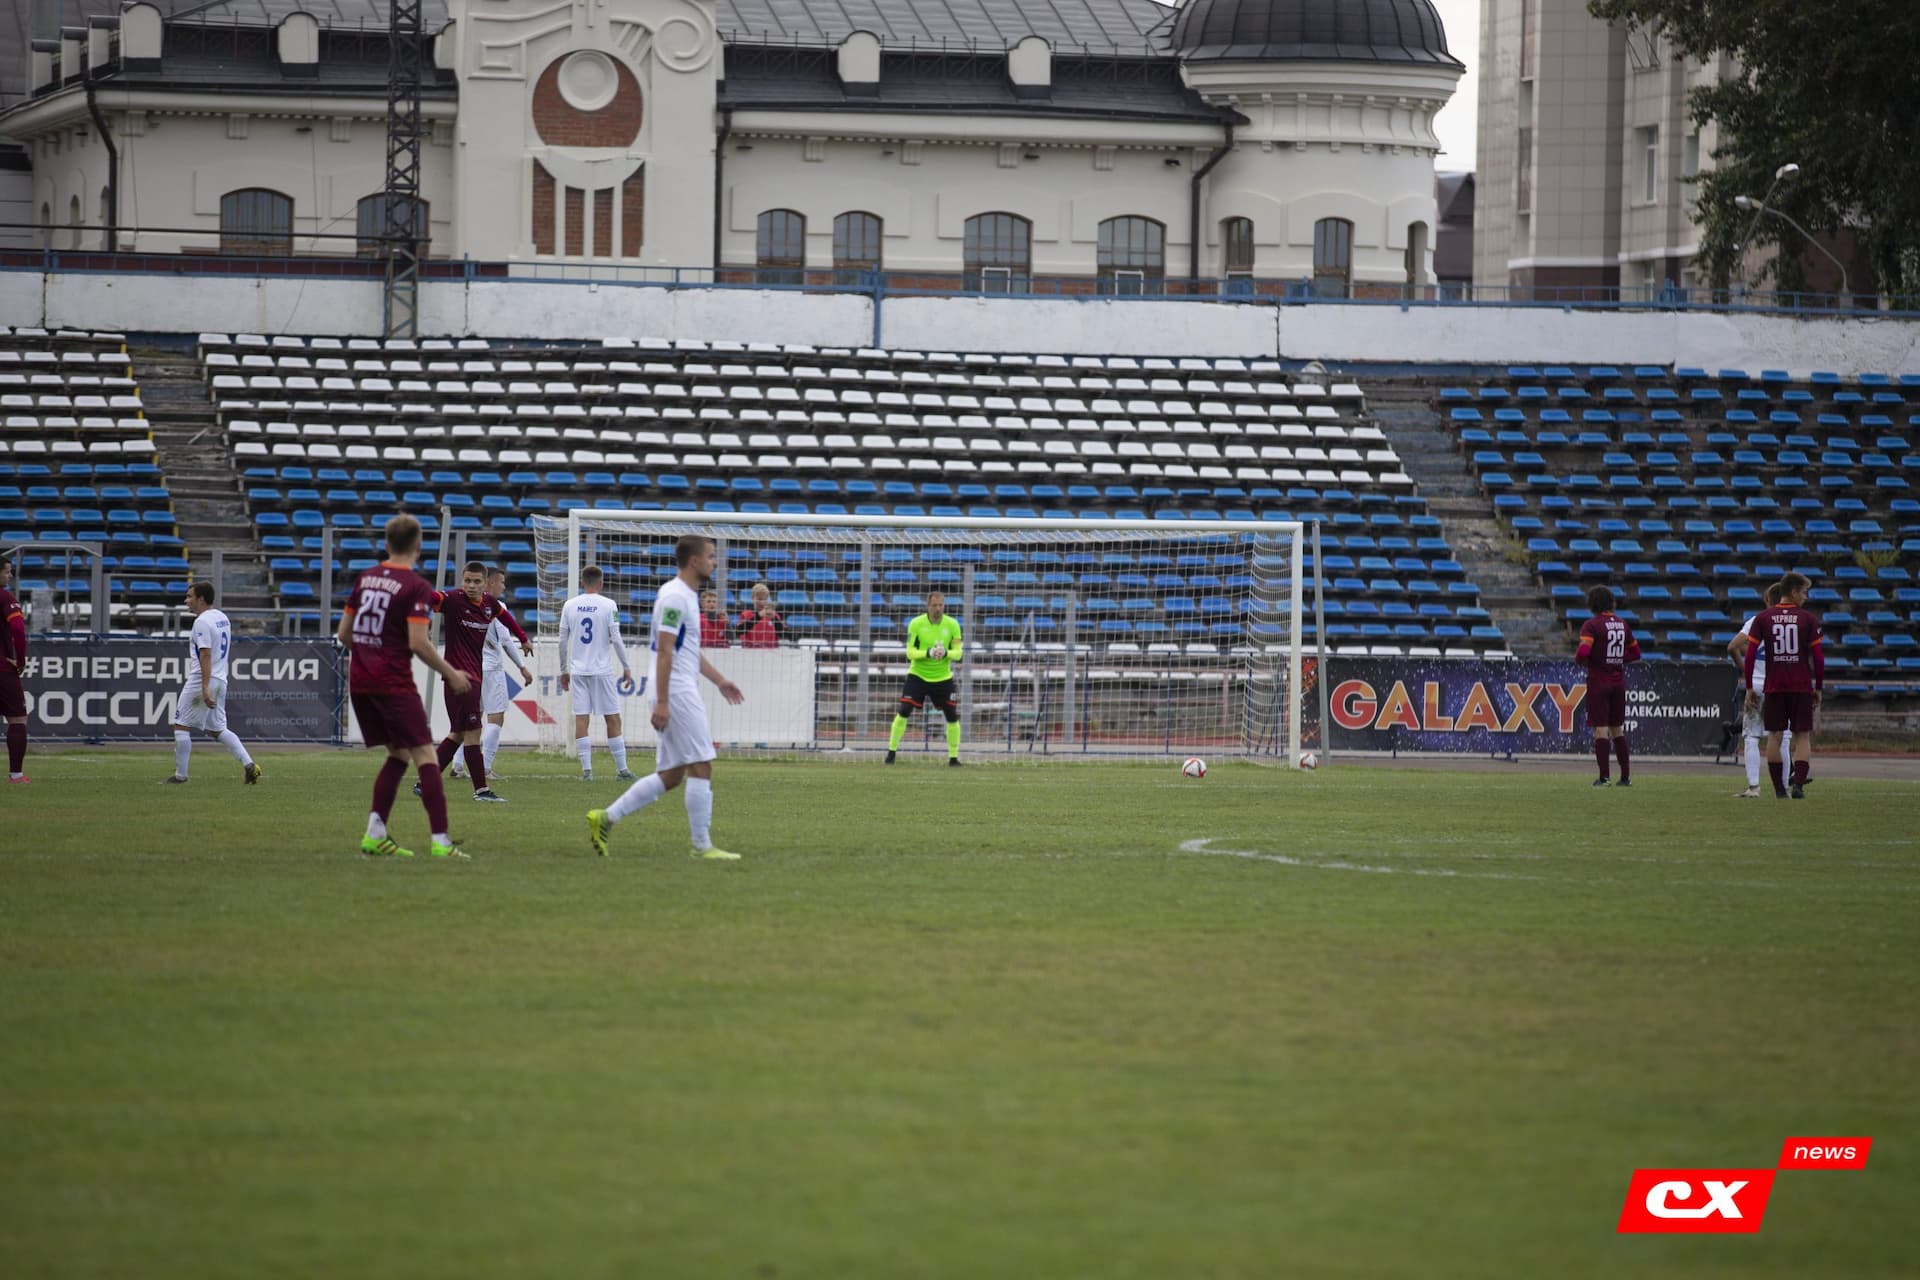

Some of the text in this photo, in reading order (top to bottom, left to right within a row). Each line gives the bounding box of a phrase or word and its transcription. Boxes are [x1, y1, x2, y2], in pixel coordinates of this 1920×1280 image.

[353, 589, 391, 636] 25
[220, 631, 228, 660] 9
[580, 617, 593, 645] 3
[1606, 630, 1625, 657] 23
[1772, 623, 1799, 655] 30
[20, 656, 319, 684] #ВПЕРЕДССИЯ
[1330, 679, 1587, 733] GALAXY
